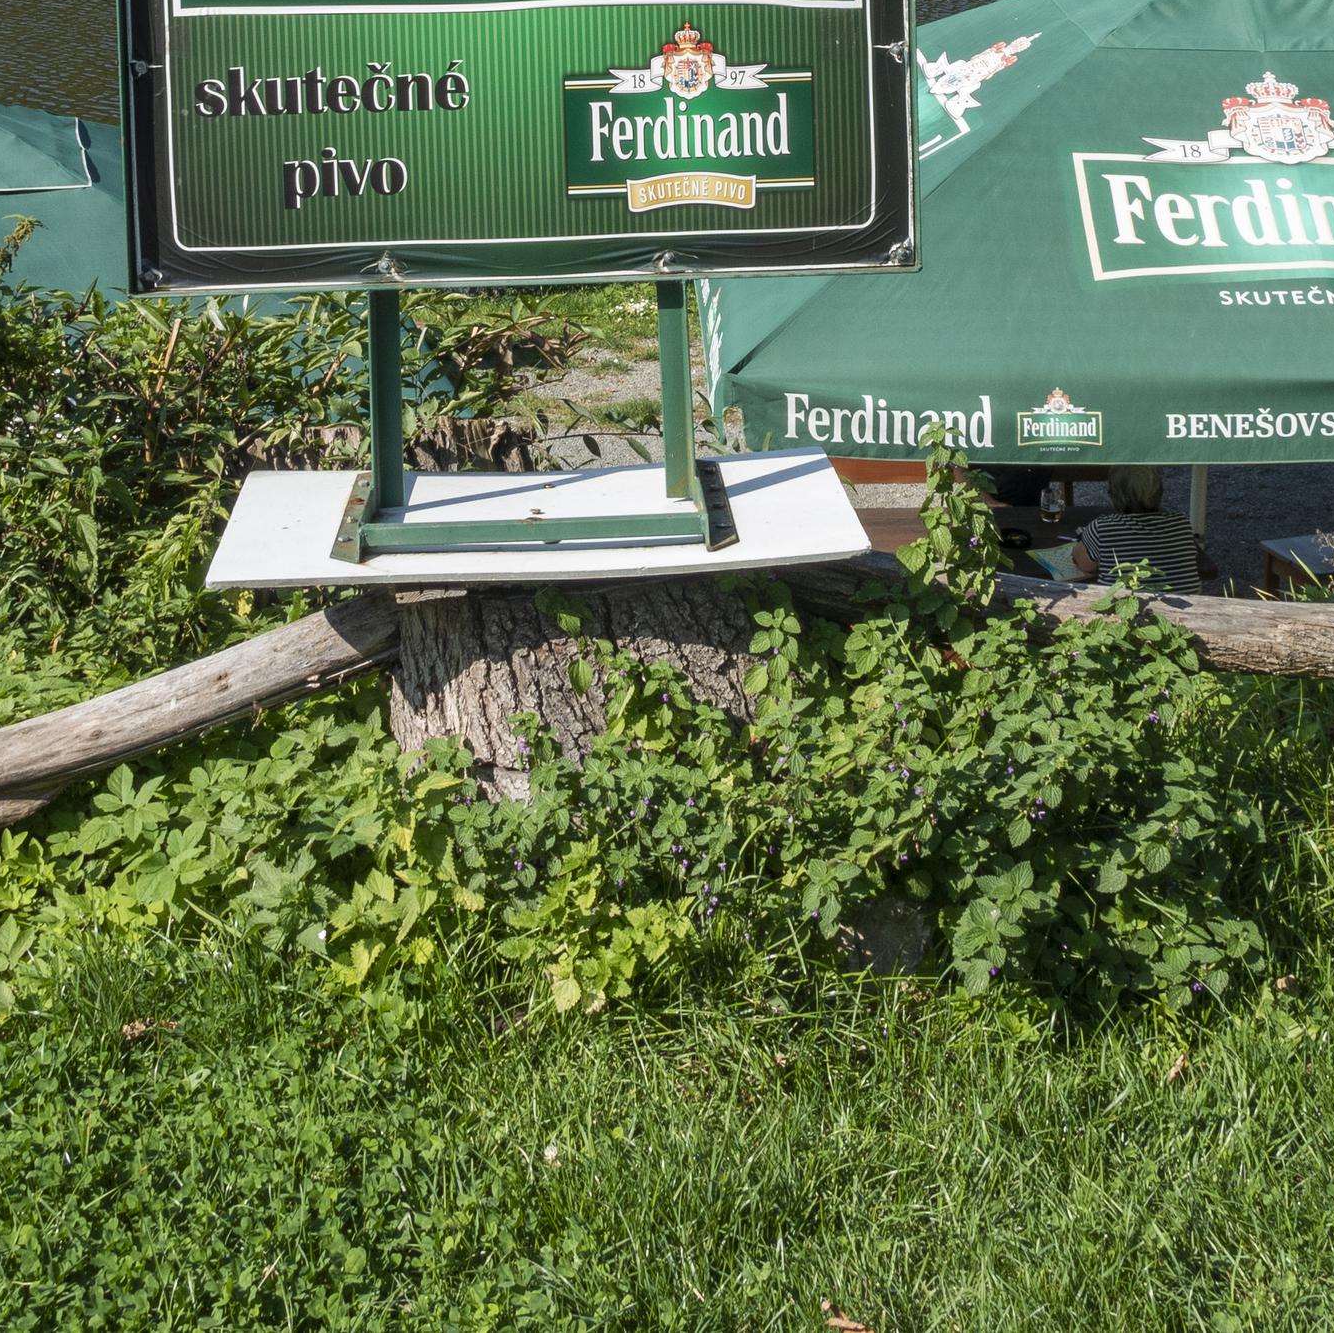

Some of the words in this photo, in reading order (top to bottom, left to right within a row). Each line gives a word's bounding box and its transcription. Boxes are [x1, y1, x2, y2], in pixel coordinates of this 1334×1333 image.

[194, 59, 470, 116] skutečné
[631, 73, 646, 89] 18
[729, 70, 746, 86] 97
[588, 92, 791, 162] Ferdinand
[1179, 143, 1202, 159] 18
[283, 147, 408, 209] pivo
[638, 176, 709, 204] SKUTEČNÉ
[717, 180, 746, 201] PIVO
[1022, 417, 1097, 438] Ferdinand
